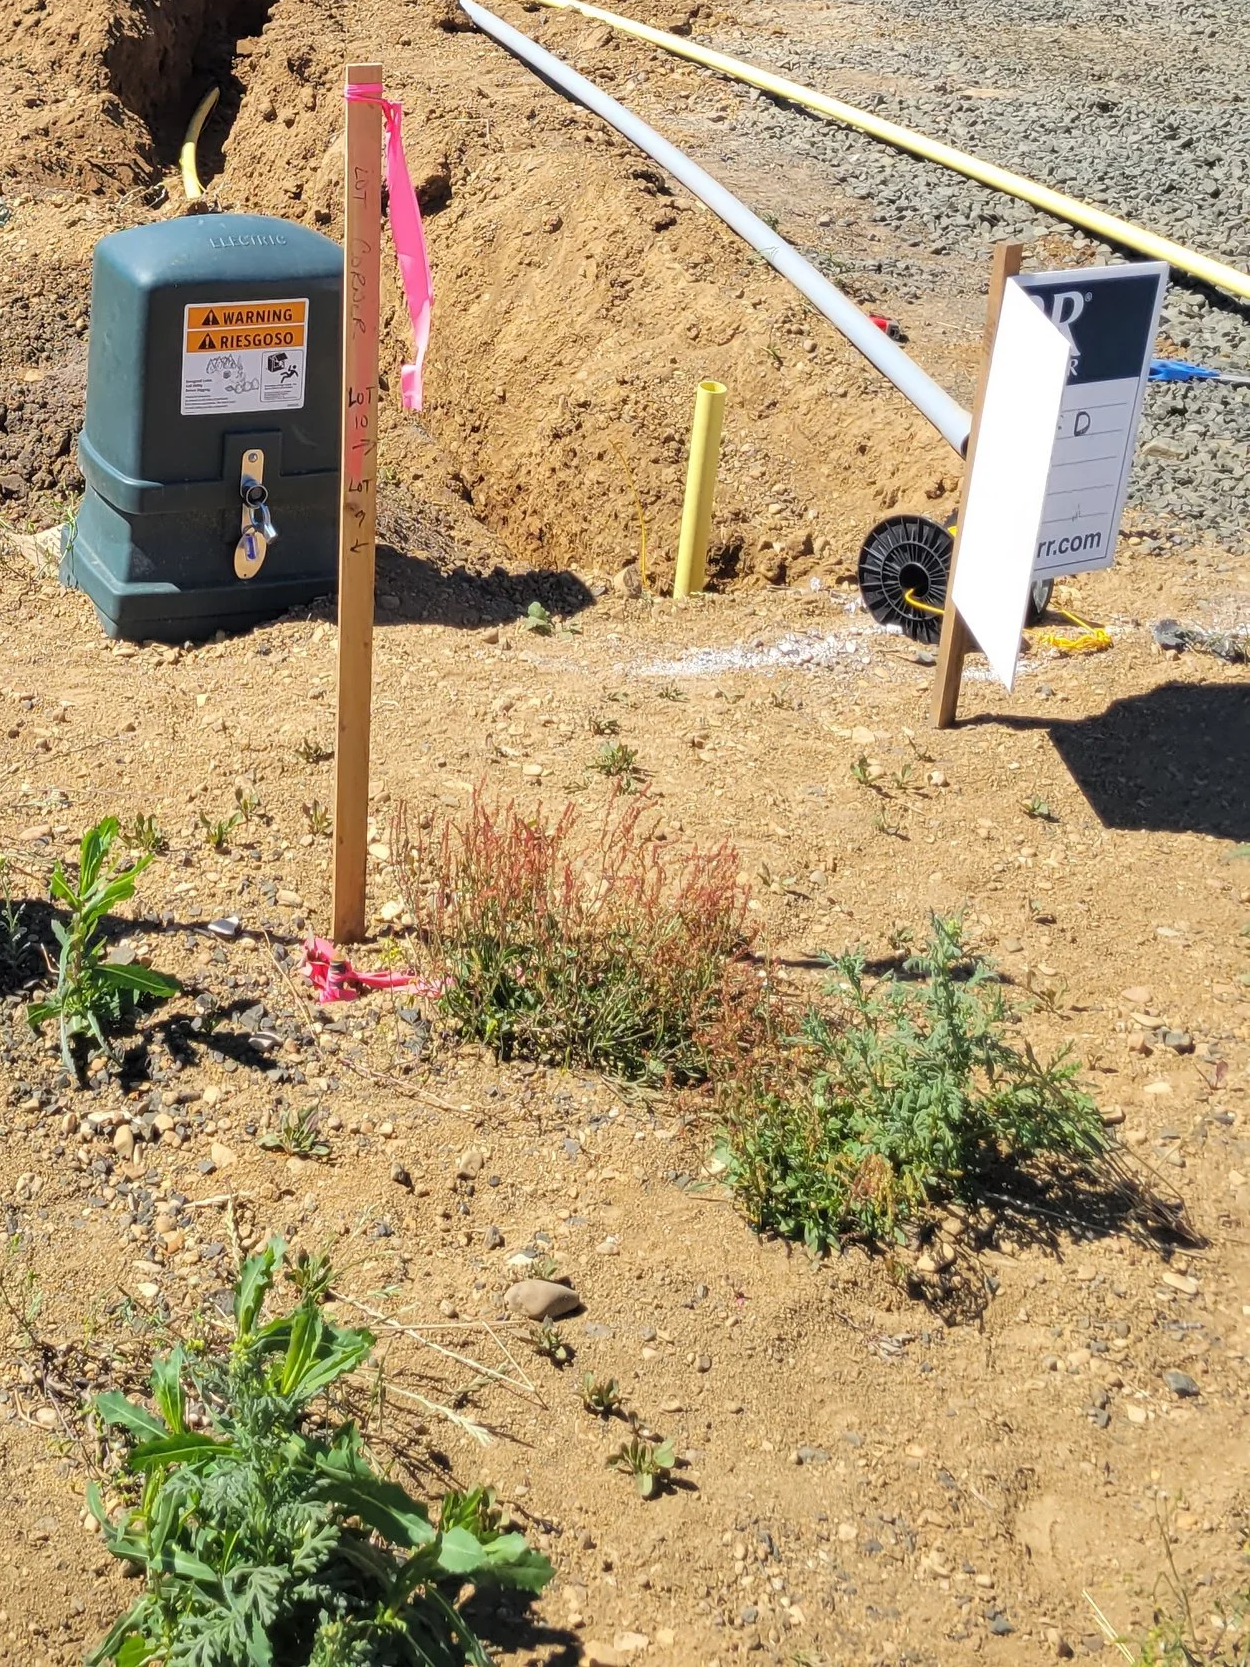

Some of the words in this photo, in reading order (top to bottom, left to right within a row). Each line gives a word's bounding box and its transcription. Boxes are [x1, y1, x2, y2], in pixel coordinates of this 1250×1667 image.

[209, 234, 287, 249] ELECTRIC
[223, 308, 293, 326] WARNING
[220, 332, 294, 349] RIESGOSO
[348, 385, 376, 408] LOT
[355, 415, 369, 429] 10
[348, 479, 372, 493] LOT
